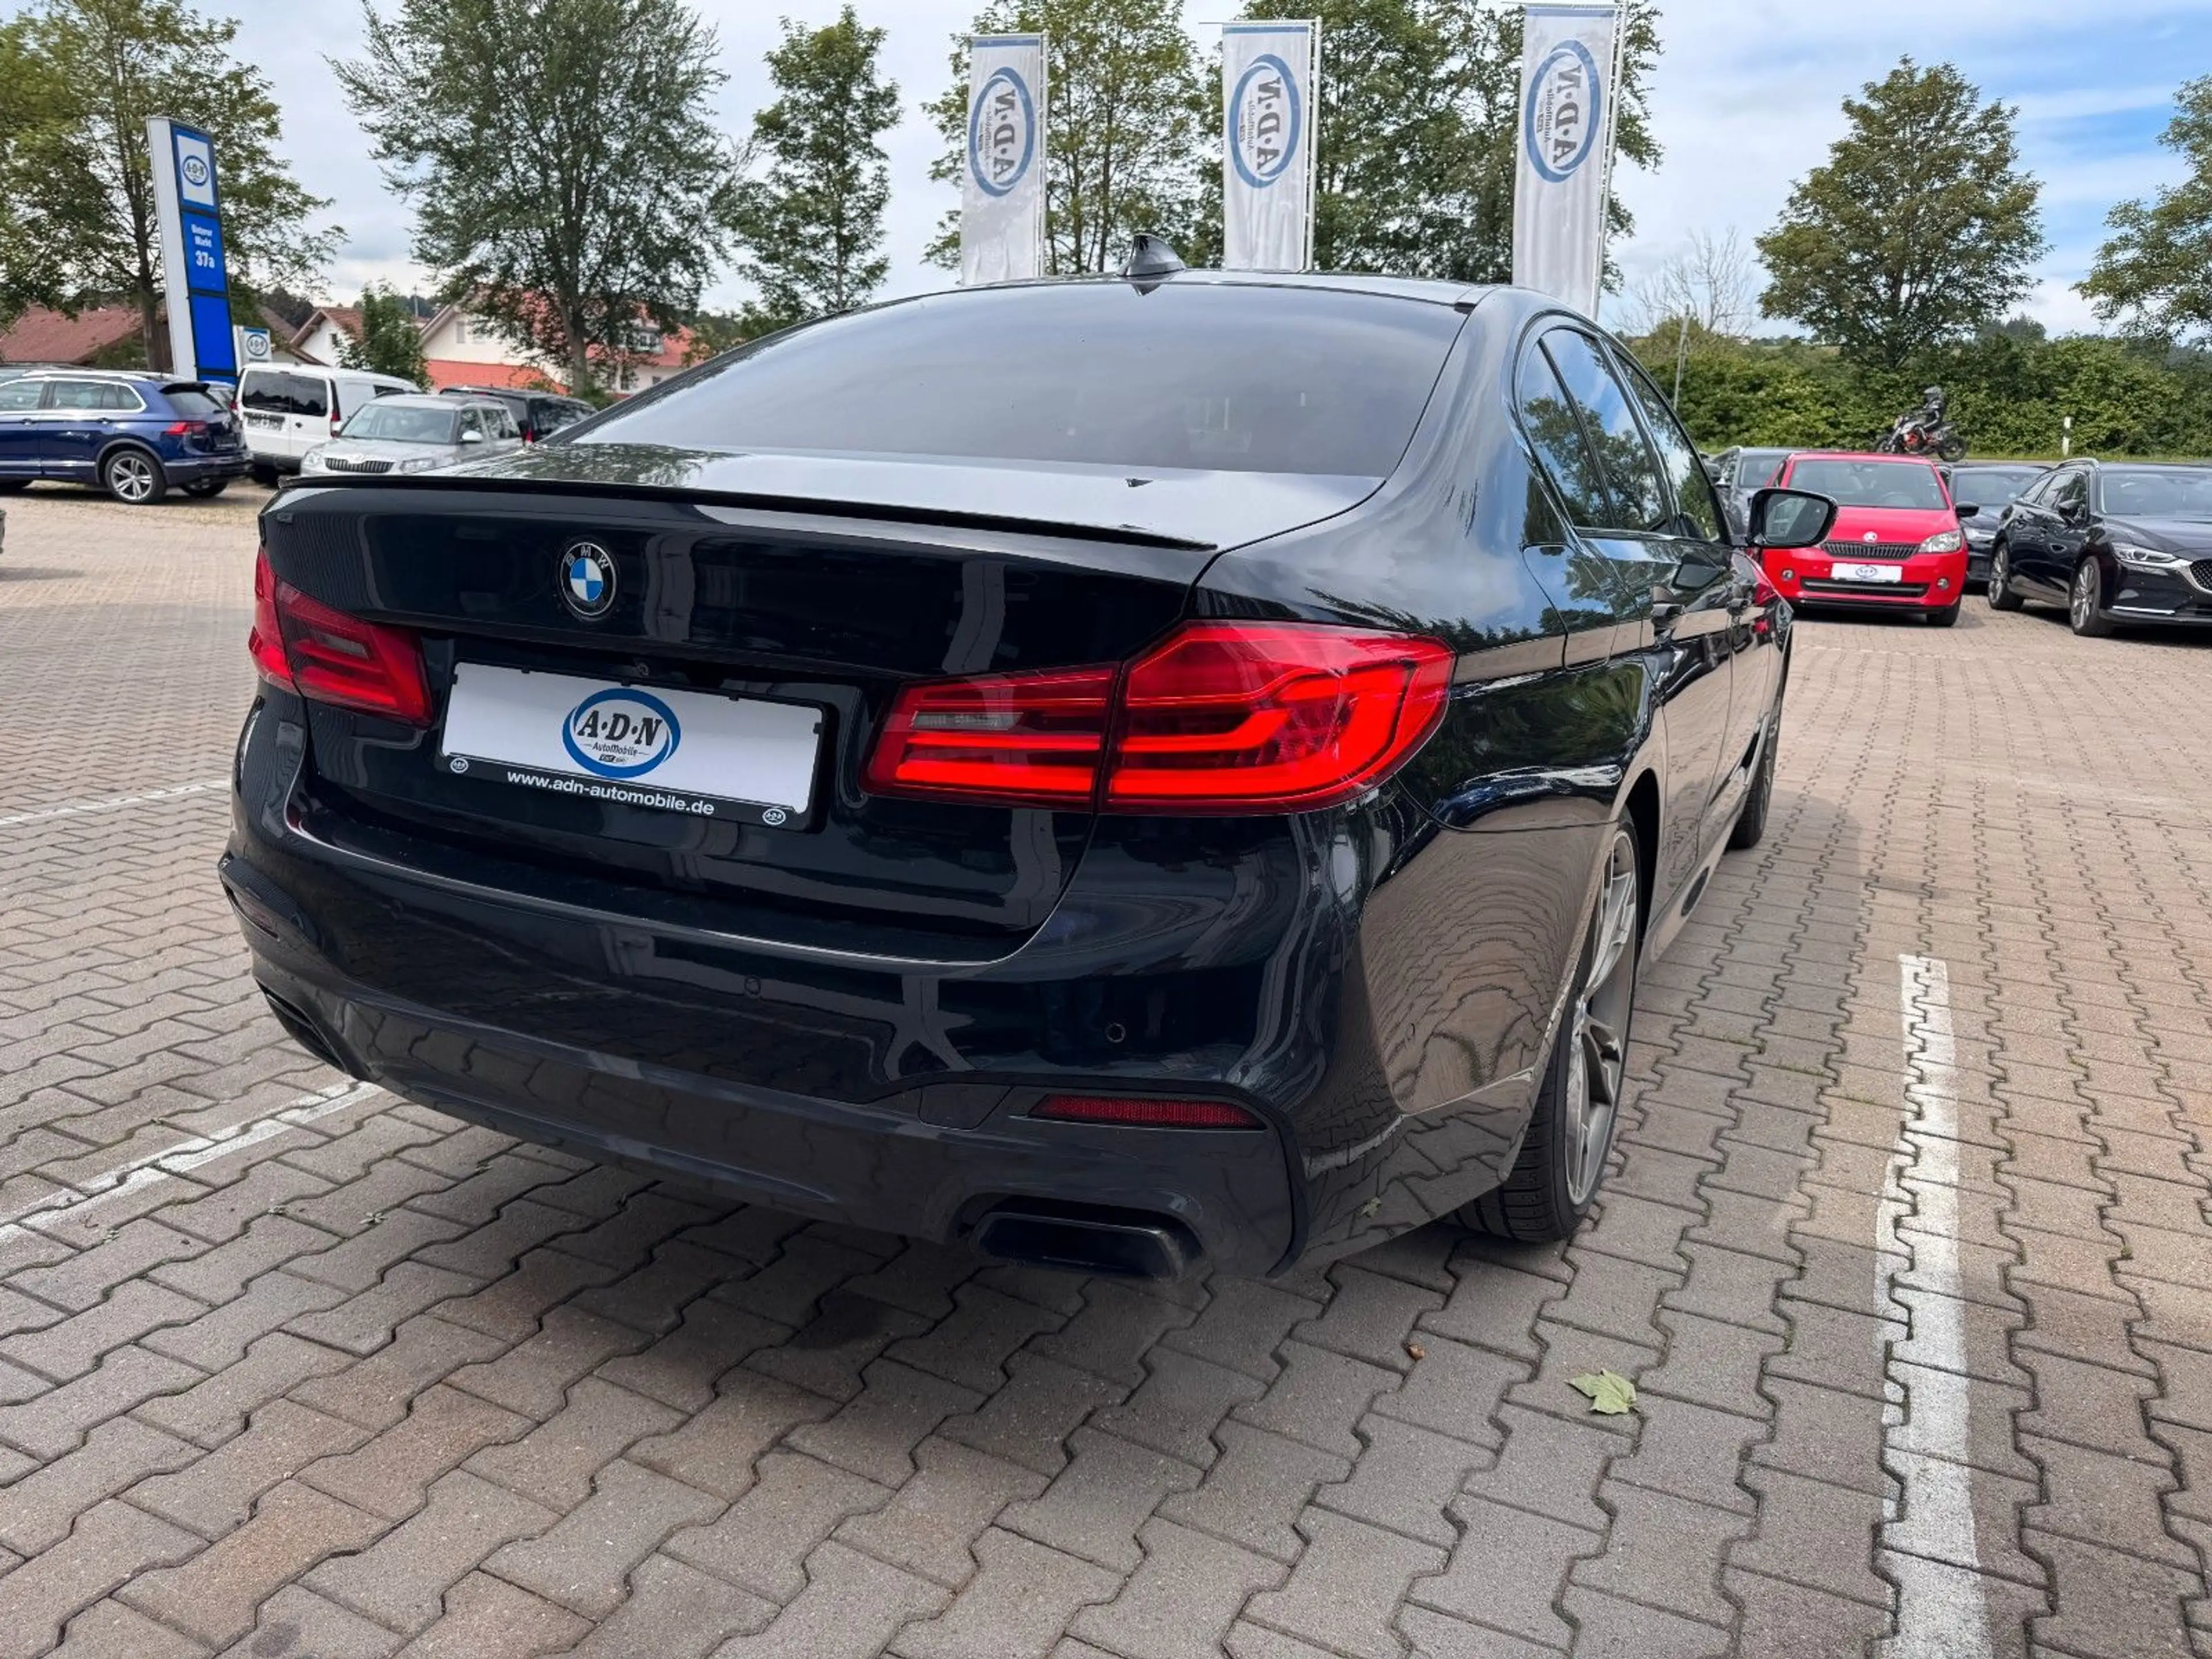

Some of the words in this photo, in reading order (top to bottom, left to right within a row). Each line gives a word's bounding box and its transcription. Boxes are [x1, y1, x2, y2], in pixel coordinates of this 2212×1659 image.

[195, 250, 215, 269] 37a
[566, 546, 610, 570] BMW
[507, 771, 715, 815] www.adn-automobile.de
